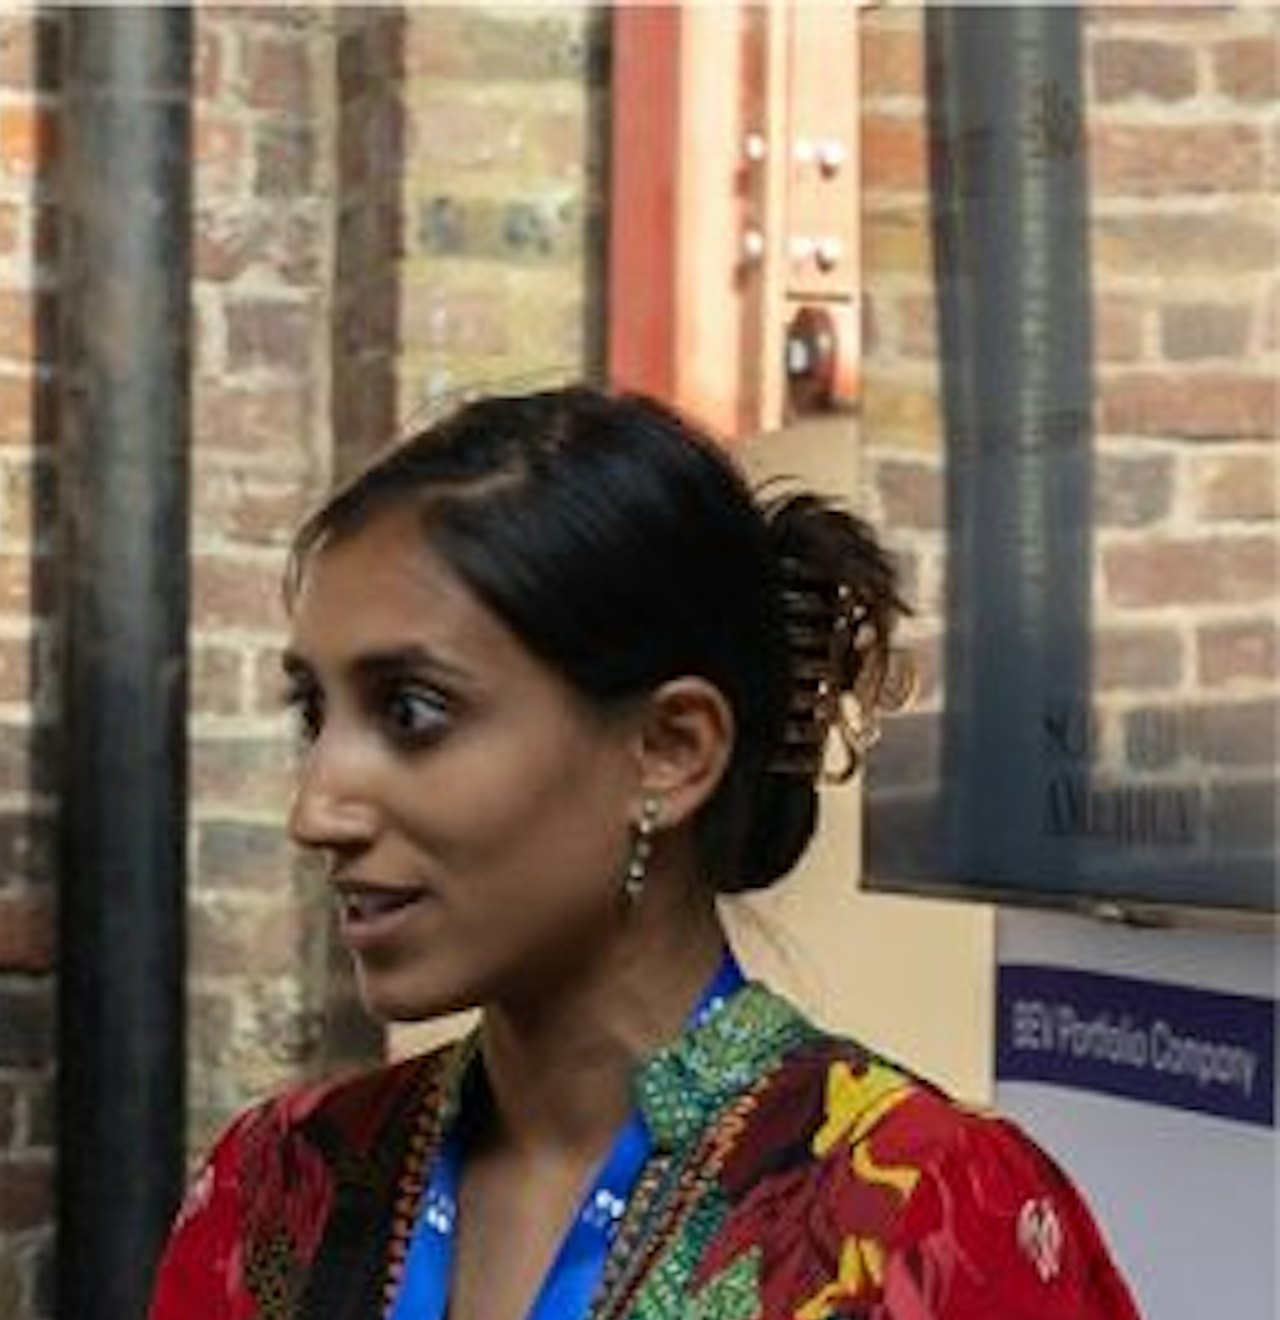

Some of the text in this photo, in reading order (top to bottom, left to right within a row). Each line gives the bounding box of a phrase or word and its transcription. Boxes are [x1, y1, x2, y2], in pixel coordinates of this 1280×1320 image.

[1013, 1000, 1257, 1098] BEV Portfolio Company
